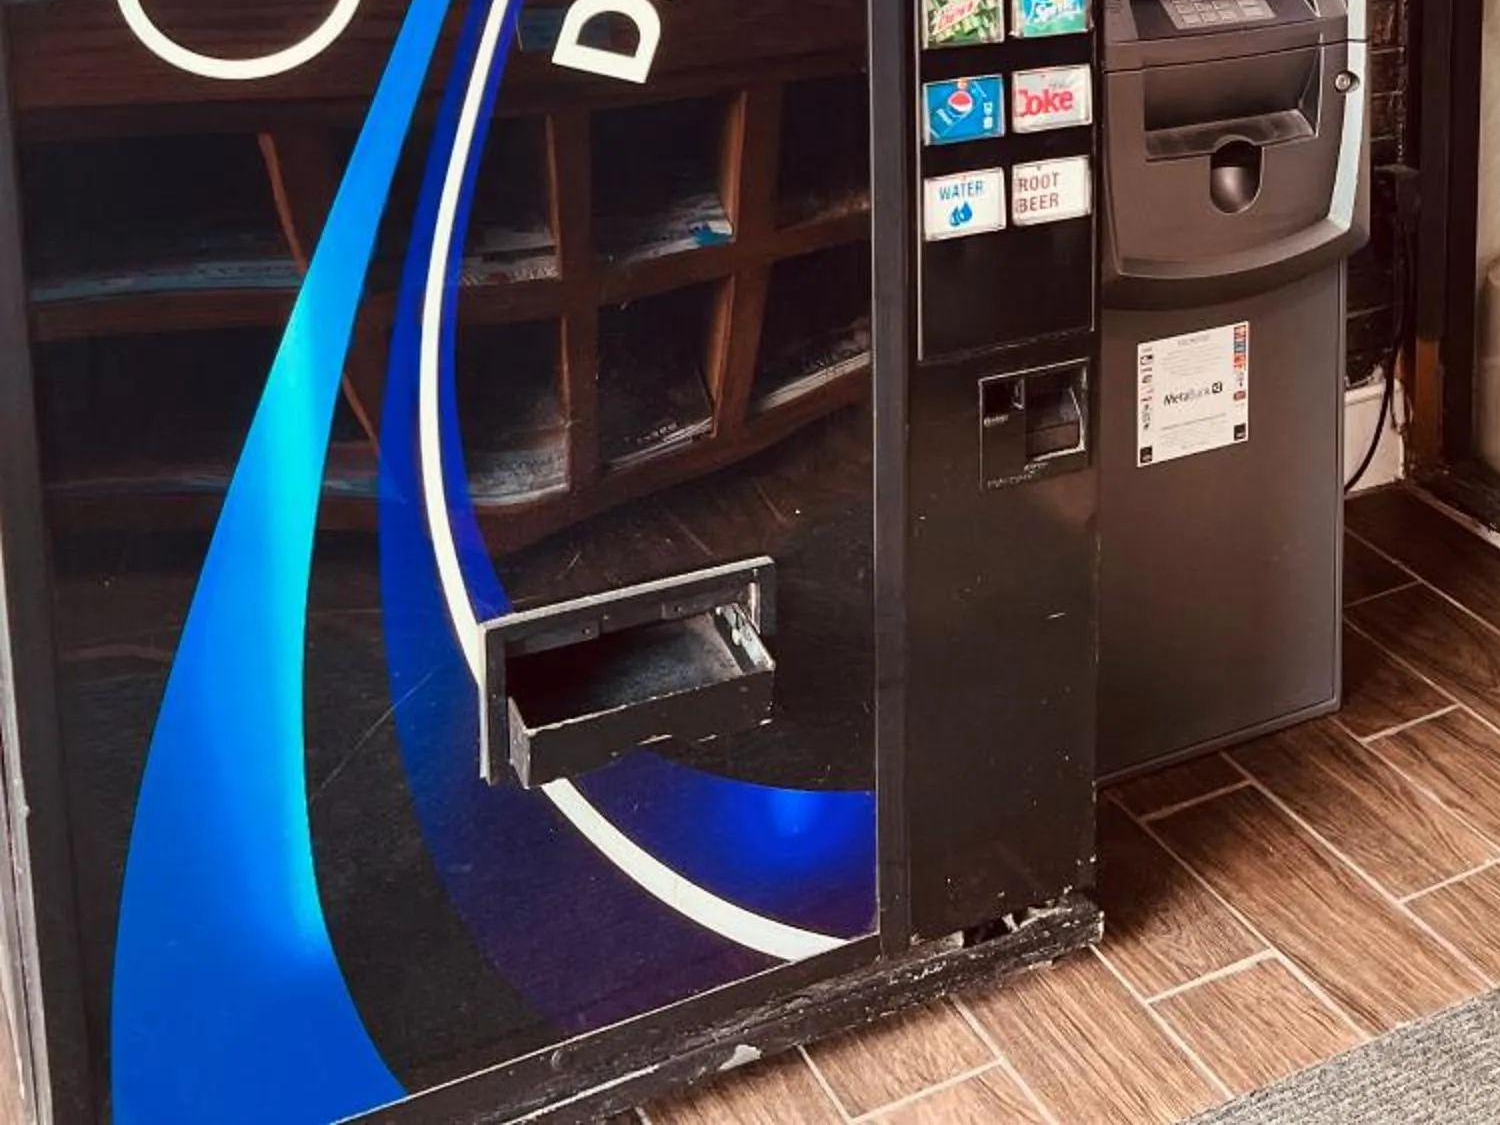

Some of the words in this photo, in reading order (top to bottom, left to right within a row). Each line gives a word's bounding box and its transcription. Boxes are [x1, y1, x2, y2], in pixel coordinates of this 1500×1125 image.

[939, 180, 983, 200] WATER
[1018, 172, 1060, 192] ROOT
[1016, 193, 1060, 214] BEER
